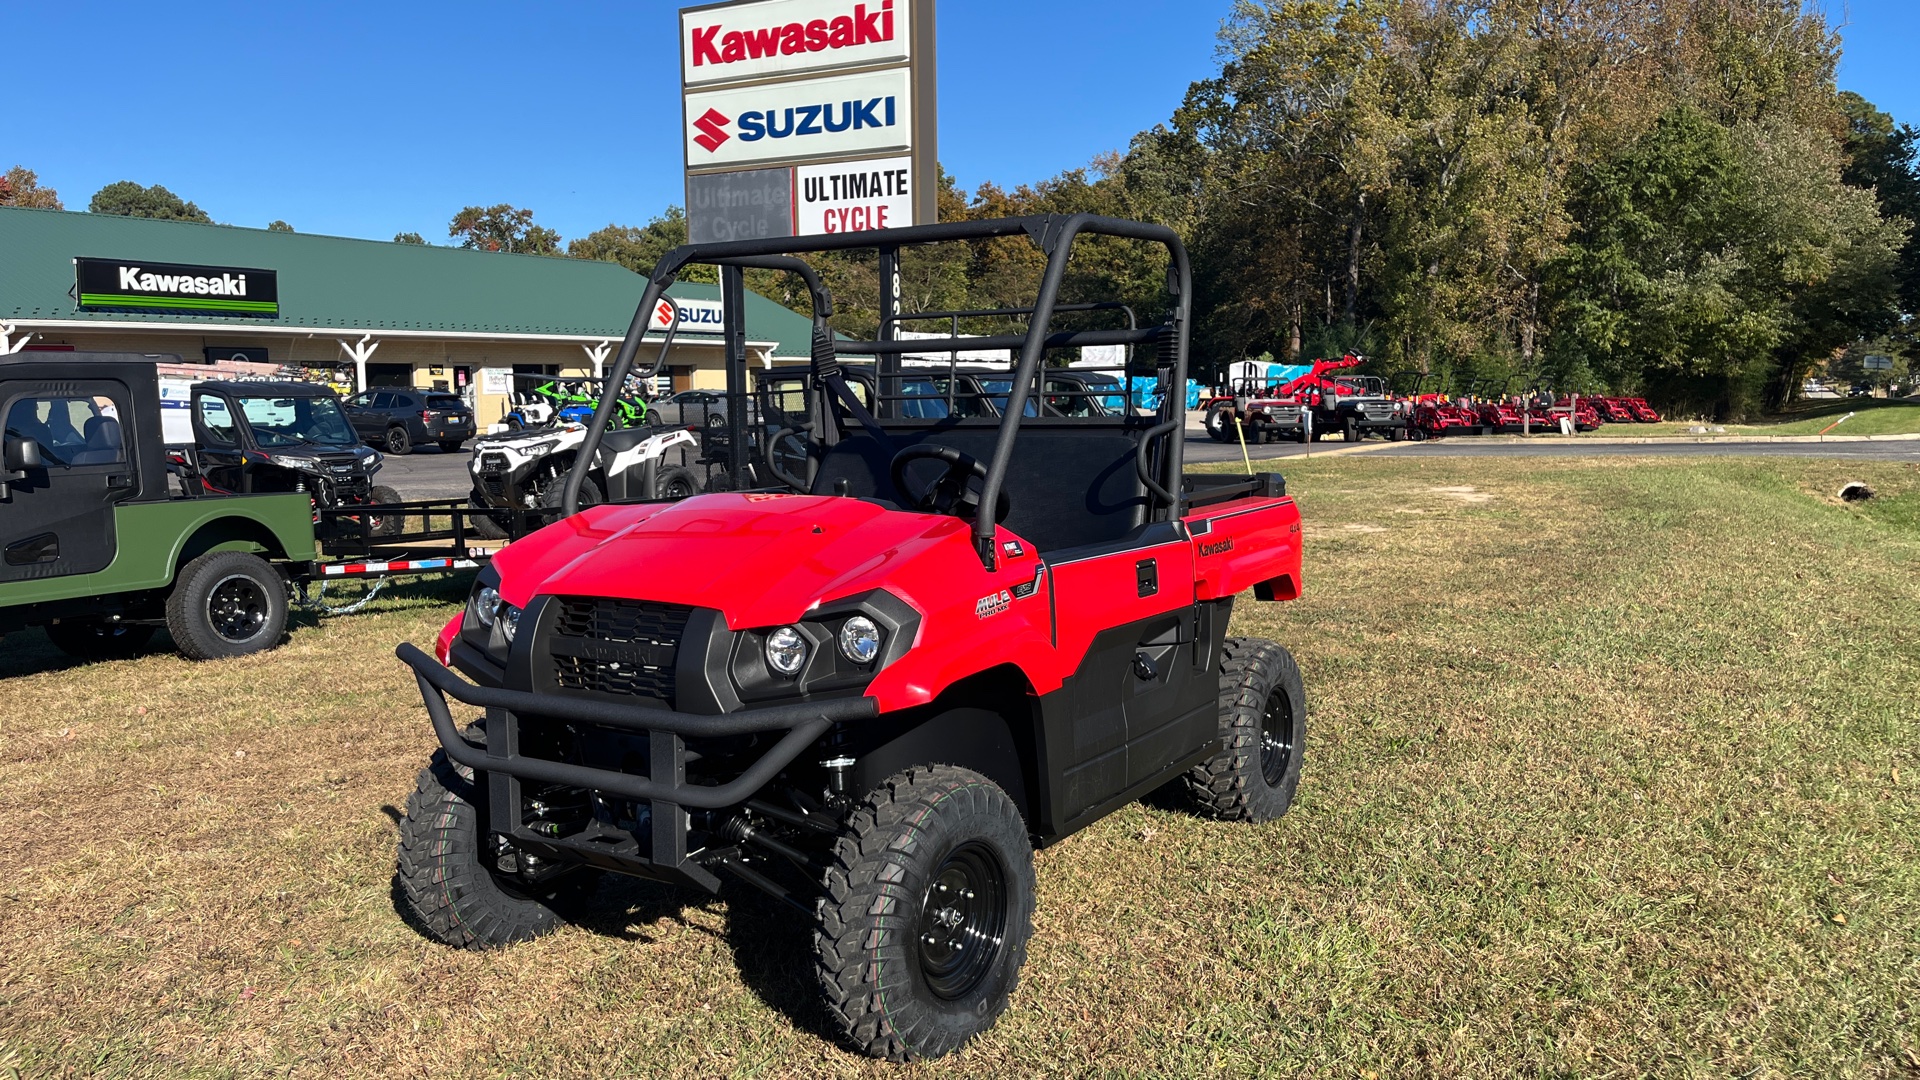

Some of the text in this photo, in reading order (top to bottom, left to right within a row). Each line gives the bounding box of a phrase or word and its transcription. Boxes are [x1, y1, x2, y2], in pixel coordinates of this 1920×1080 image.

[691, 0, 894, 67] Kawasaki
[737, 95, 895, 142] SUZUKI
[695, 183, 785, 209] Ultimate
[804, 169, 908, 202] ULTIMATE
[712, 214, 769, 242] Cycle
[823, 205, 889, 235] CYCLE
[118, 266, 247, 297] Kawasaki
[679, 307, 724, 324] SUZU
[1197, 535, 1234, 558] Kawasaki
[975, 590, 1012, 614] MULE
[979, 604, 1008, 619] PRO MX
